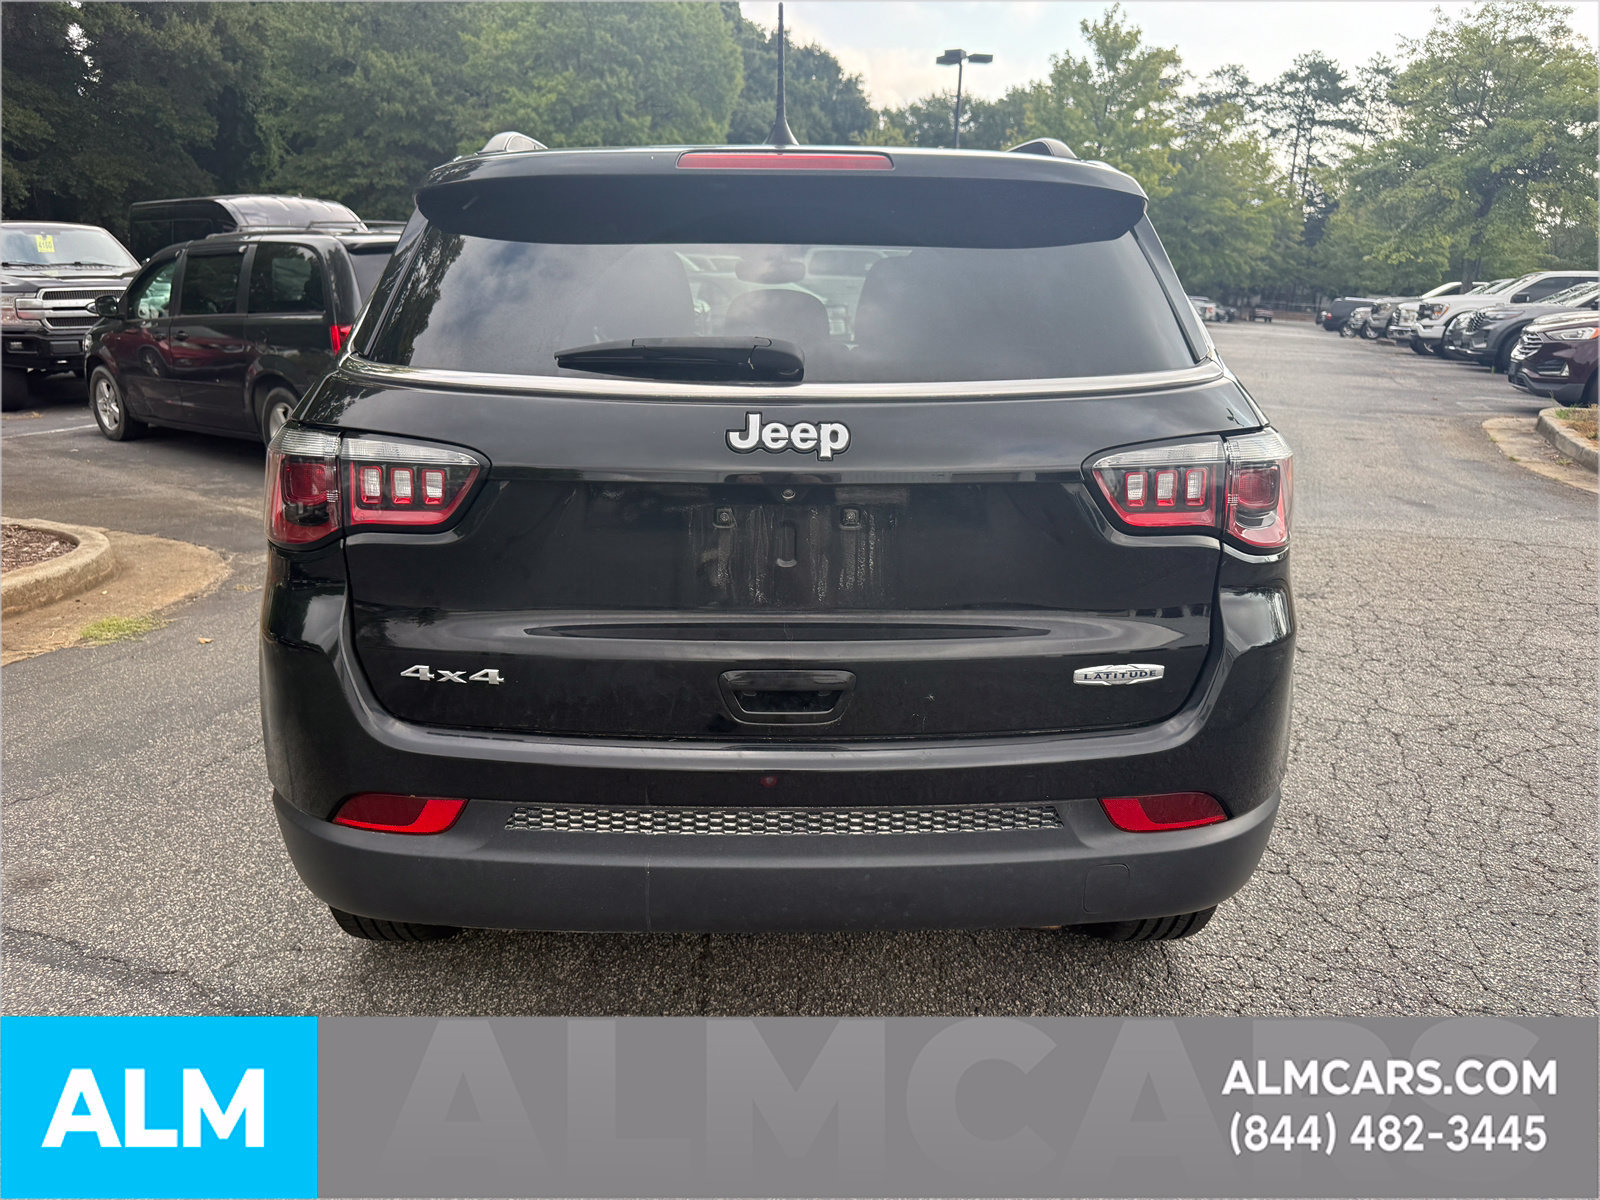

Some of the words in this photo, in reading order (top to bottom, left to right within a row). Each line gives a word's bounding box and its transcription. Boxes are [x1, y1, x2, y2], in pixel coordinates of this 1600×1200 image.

[726, 412, 851, 460] Jeep
[400, 664, 505, 685] 4x4
[1083, 669, 1157, 681] LATITUDE
